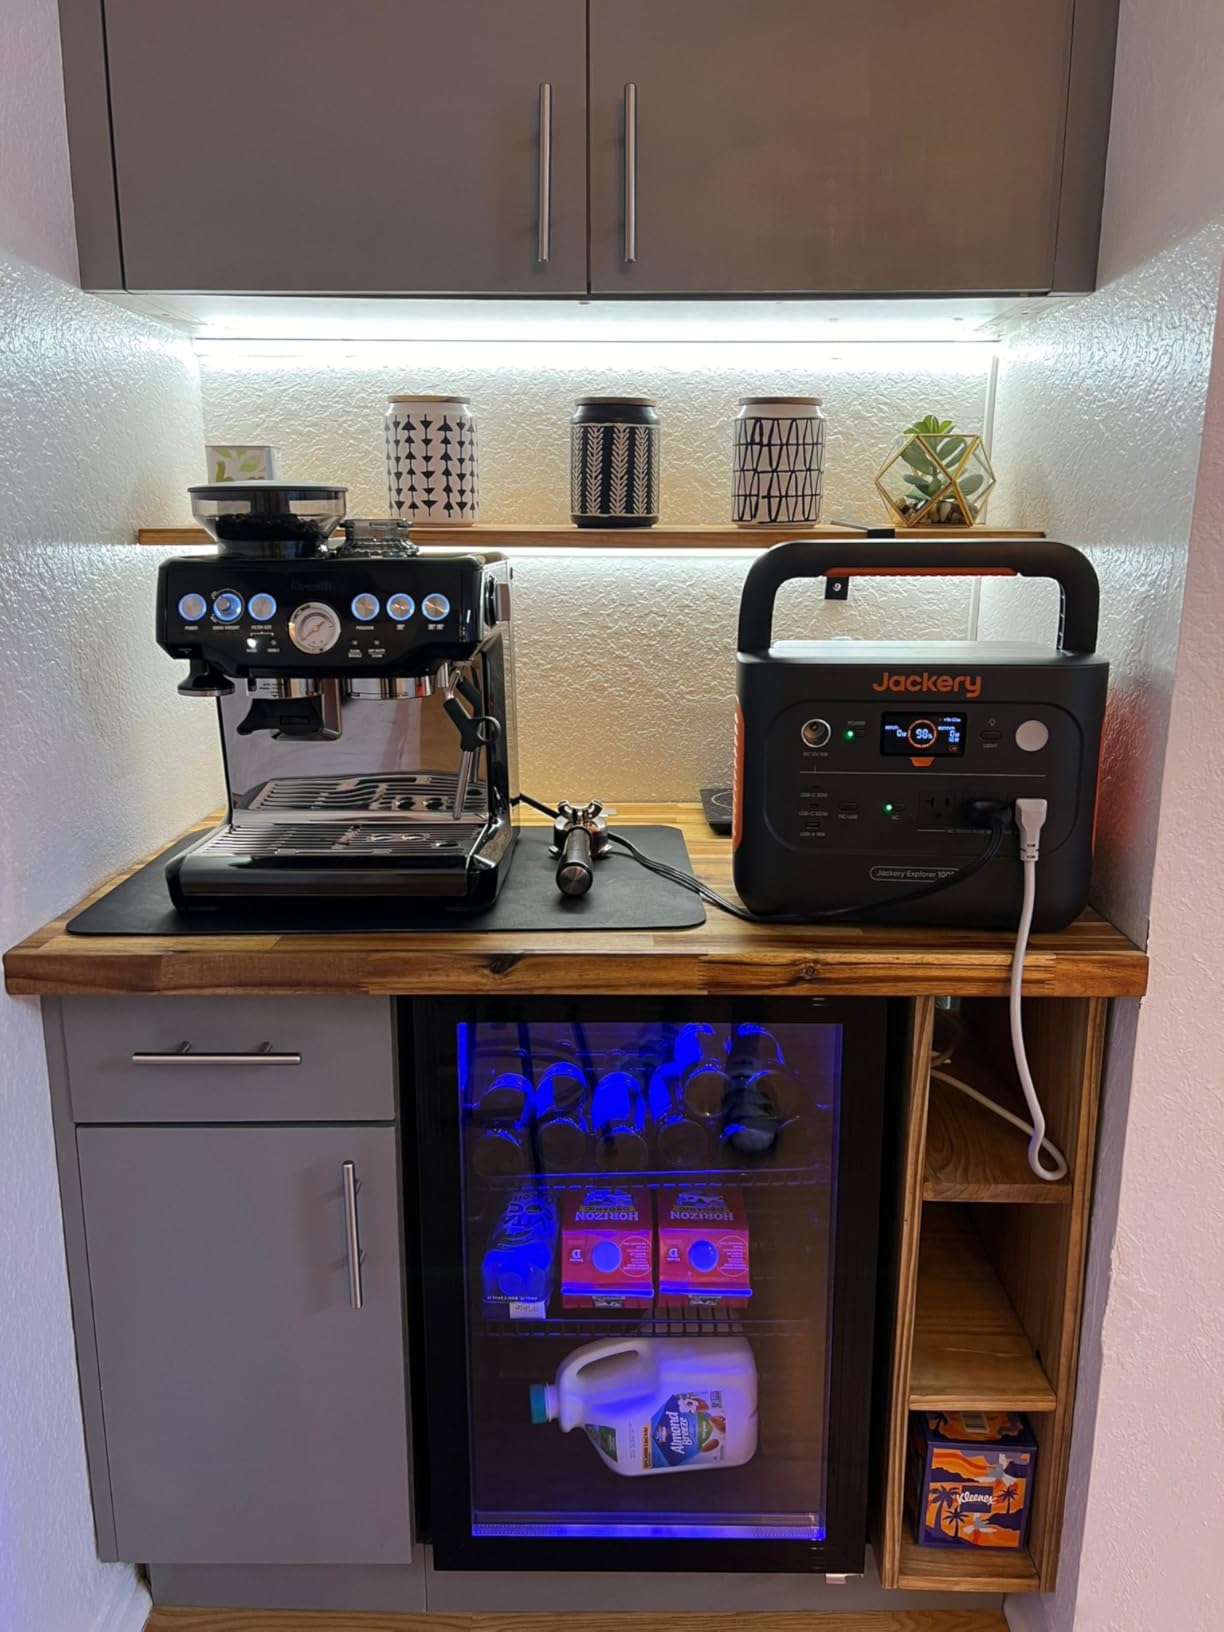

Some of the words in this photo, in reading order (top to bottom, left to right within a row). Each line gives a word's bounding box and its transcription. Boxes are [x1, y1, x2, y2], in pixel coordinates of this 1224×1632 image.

[872, 672, 982, 698] Jackery
[876, 869, 906, 879] Jackery
[906, 870, 937, 880] Explorer
[575, 1211, 639, 1221] HORIZON
[670, 1210, 735, 1221] HORIZON
[666, 1411, 686, 1455] Almond
[679, 1417, 693, 1446] Breeze
[956, 1490, 998, 1505] Kleenex
